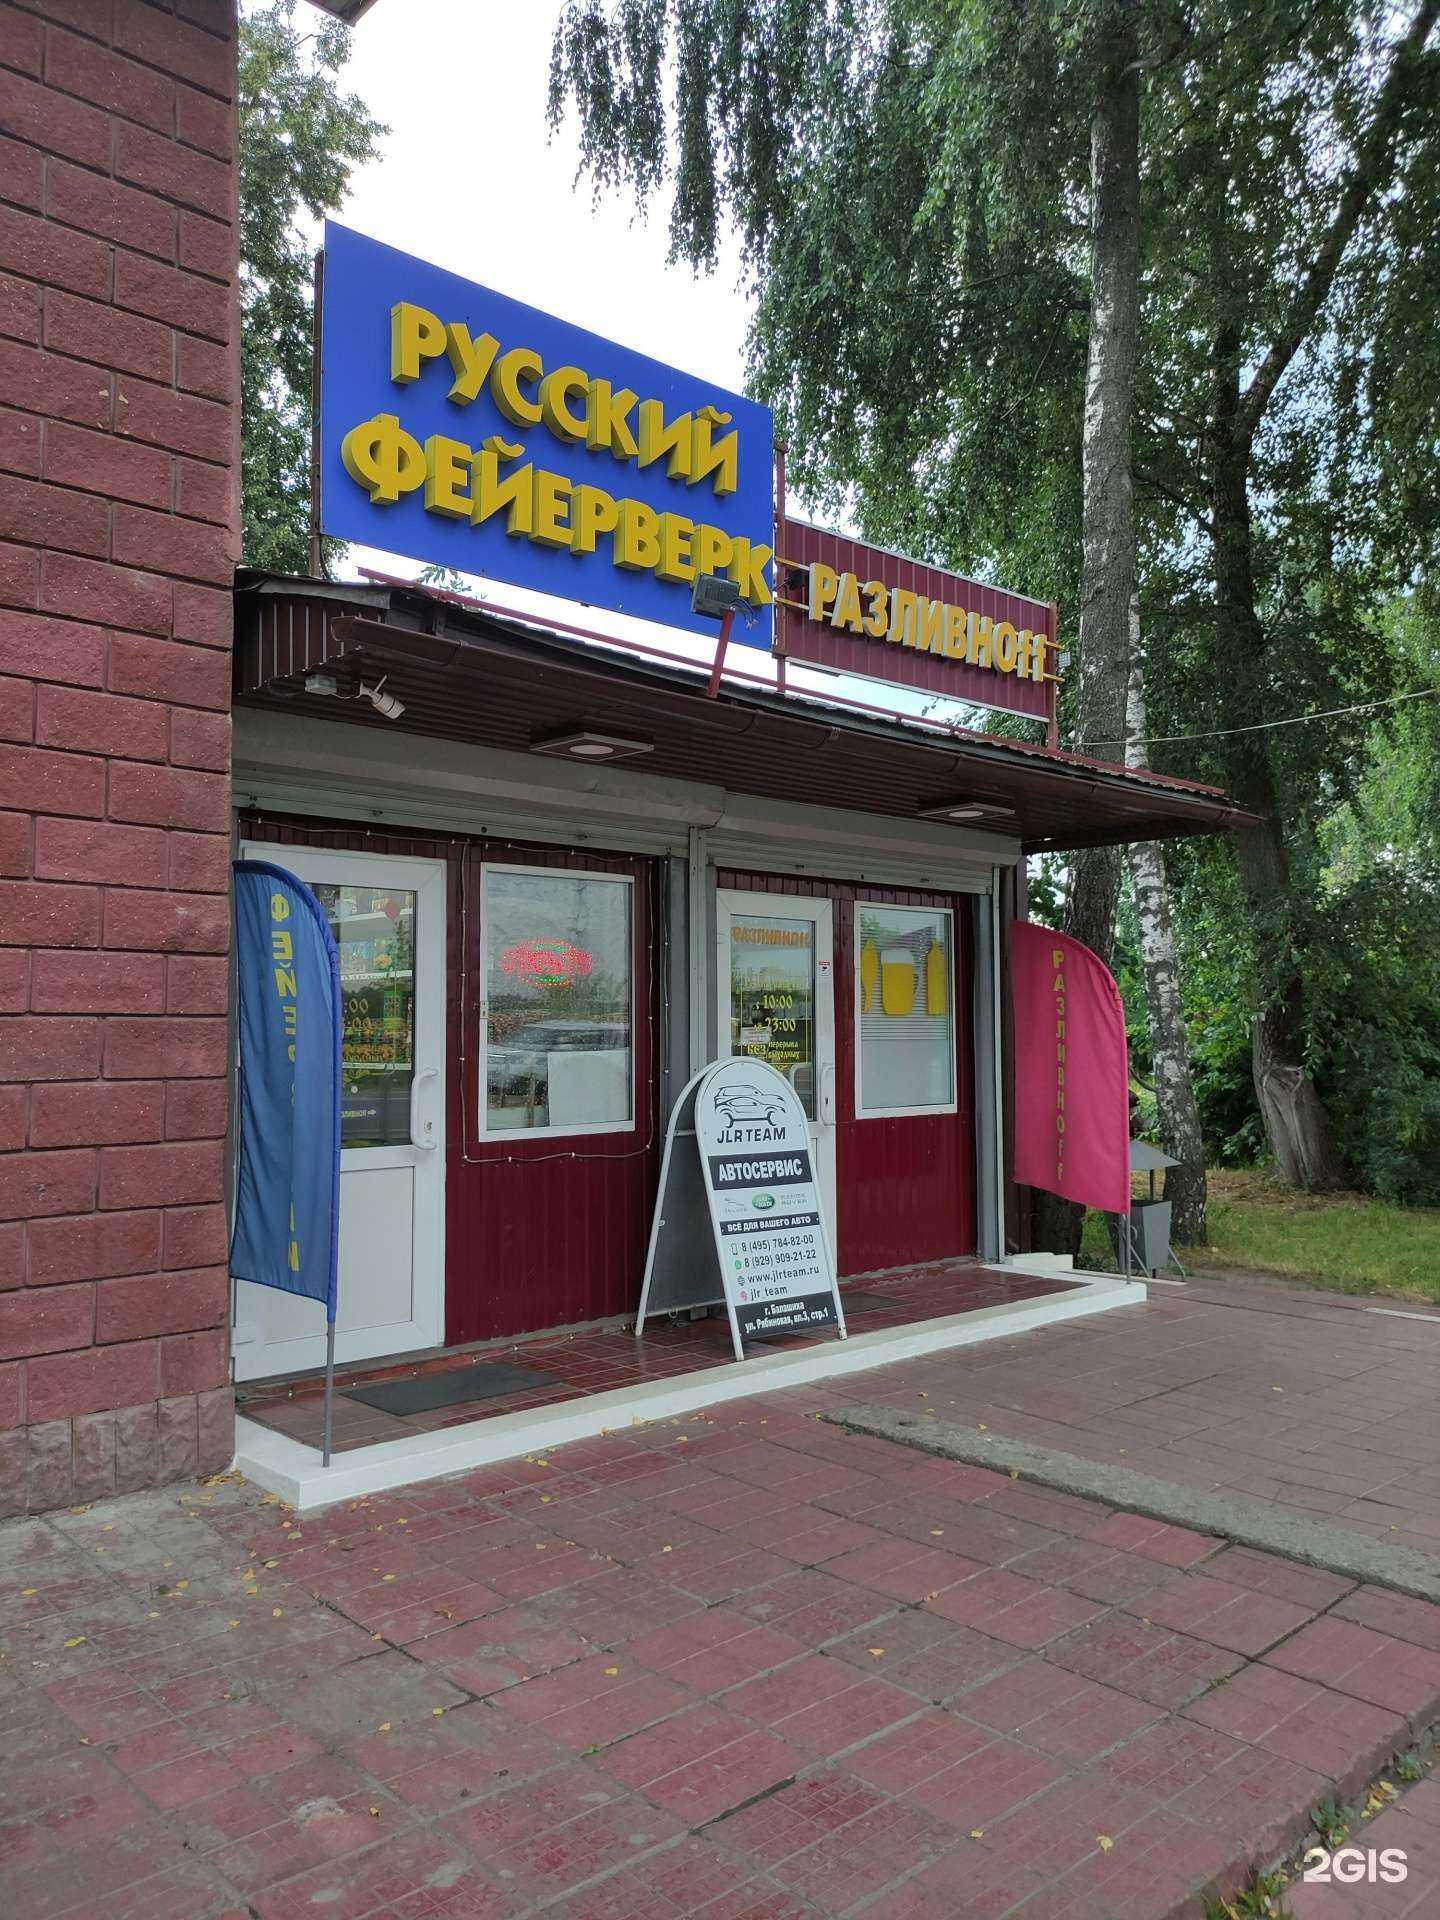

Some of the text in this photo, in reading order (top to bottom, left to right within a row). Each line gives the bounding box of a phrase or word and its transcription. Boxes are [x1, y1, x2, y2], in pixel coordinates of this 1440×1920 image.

[390, 301, 738, 496] РУССКИЙ
[341, 413, 774, 604] ФЕЙЕРВЕРК
[763, 994, 793, 1009] 10:00
[717, 1127, 786, 1143] JLR TEAM
[719, 1158, 803, 1181] АВТОСЕРВИС
[743, 1222, 759, 1232] ДЛЯ
[760, 1218, 790, 1229] ВАШЕГО
[791, 1215, 811, 1225] АВТО
[741, 1234, 814, 1253] 8 (495) 784-82-00
[744, 1249, 817, 1269] 8 (929) 909-21-22
[748, 1265, 819, 1282] www.jlrteam.ru
[744, 1322, 756, 1334] ул.
[810, 1306, 829, 1321] стр.1
